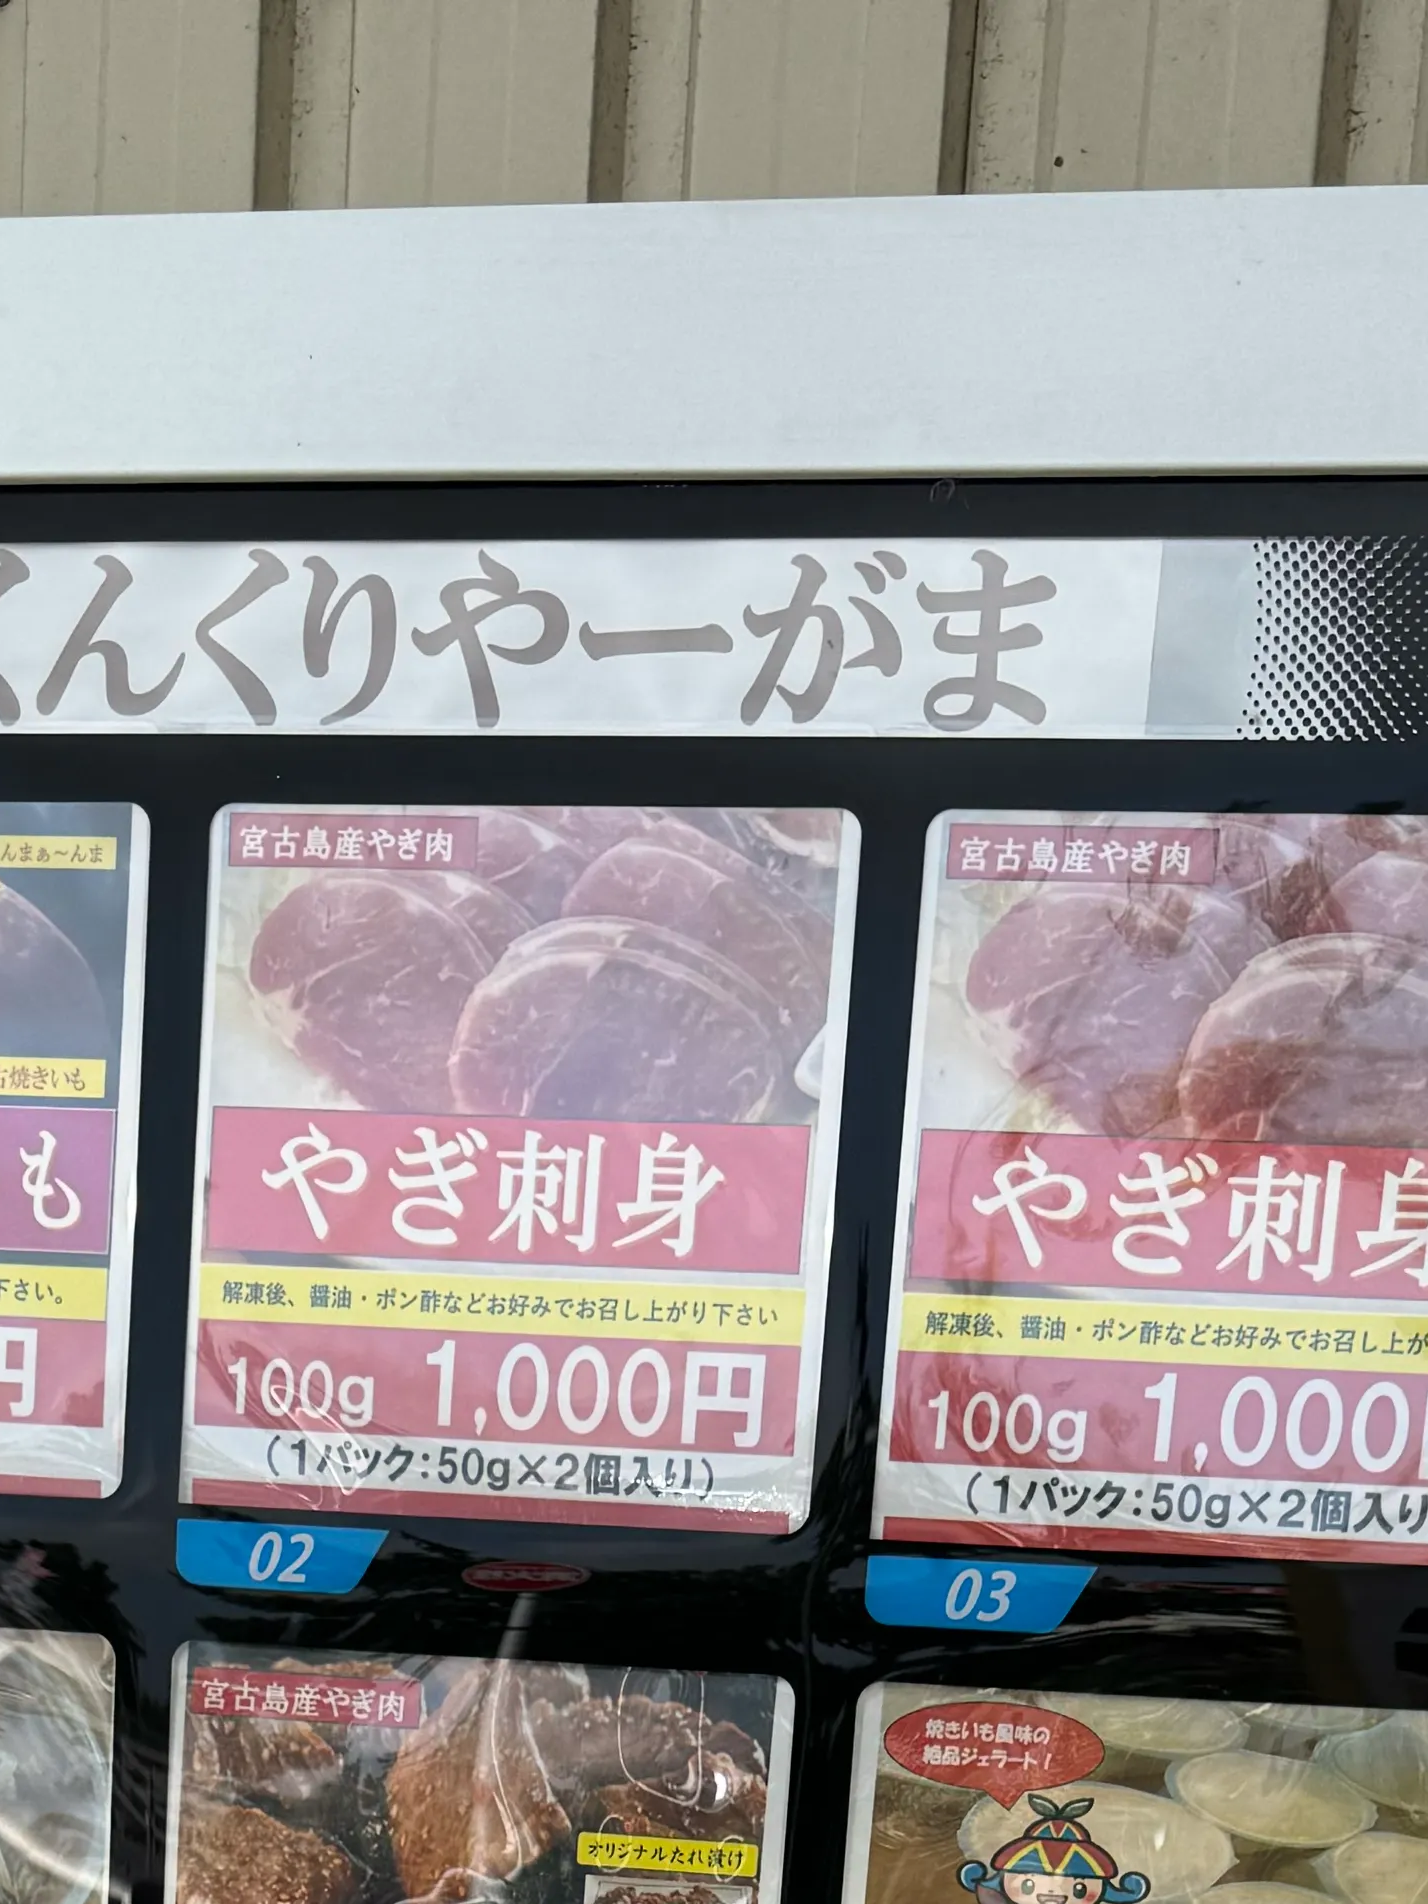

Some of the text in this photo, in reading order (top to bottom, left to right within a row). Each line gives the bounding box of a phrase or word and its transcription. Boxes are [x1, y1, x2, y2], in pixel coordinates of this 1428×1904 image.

[239, 825, 454, 862] 宮古島産やぎ肉
[959, 837, 1192, 876] 宮古島産やぎ肉
[261, 1121, 726, 1258] やぎ刺身
[222, 1279, 779, 1328] 解凍後、醤油・ポン酢などお好みでお召し上がり下さい
[227, 1339, 767, 1449] 100g 1,000円
[927, 1389, 1088, 1464] 100g
[247, 1531, 314, 1583] 02
[944, 1568, 1017, 1622] 03
[201, 1678, 406, 1723] 宮古島産やぎ肉
[925, 1717, 1051, 1747] 焼きいも風味の
[586, 1840, 744, 1870] オリジナルたれ漬け
